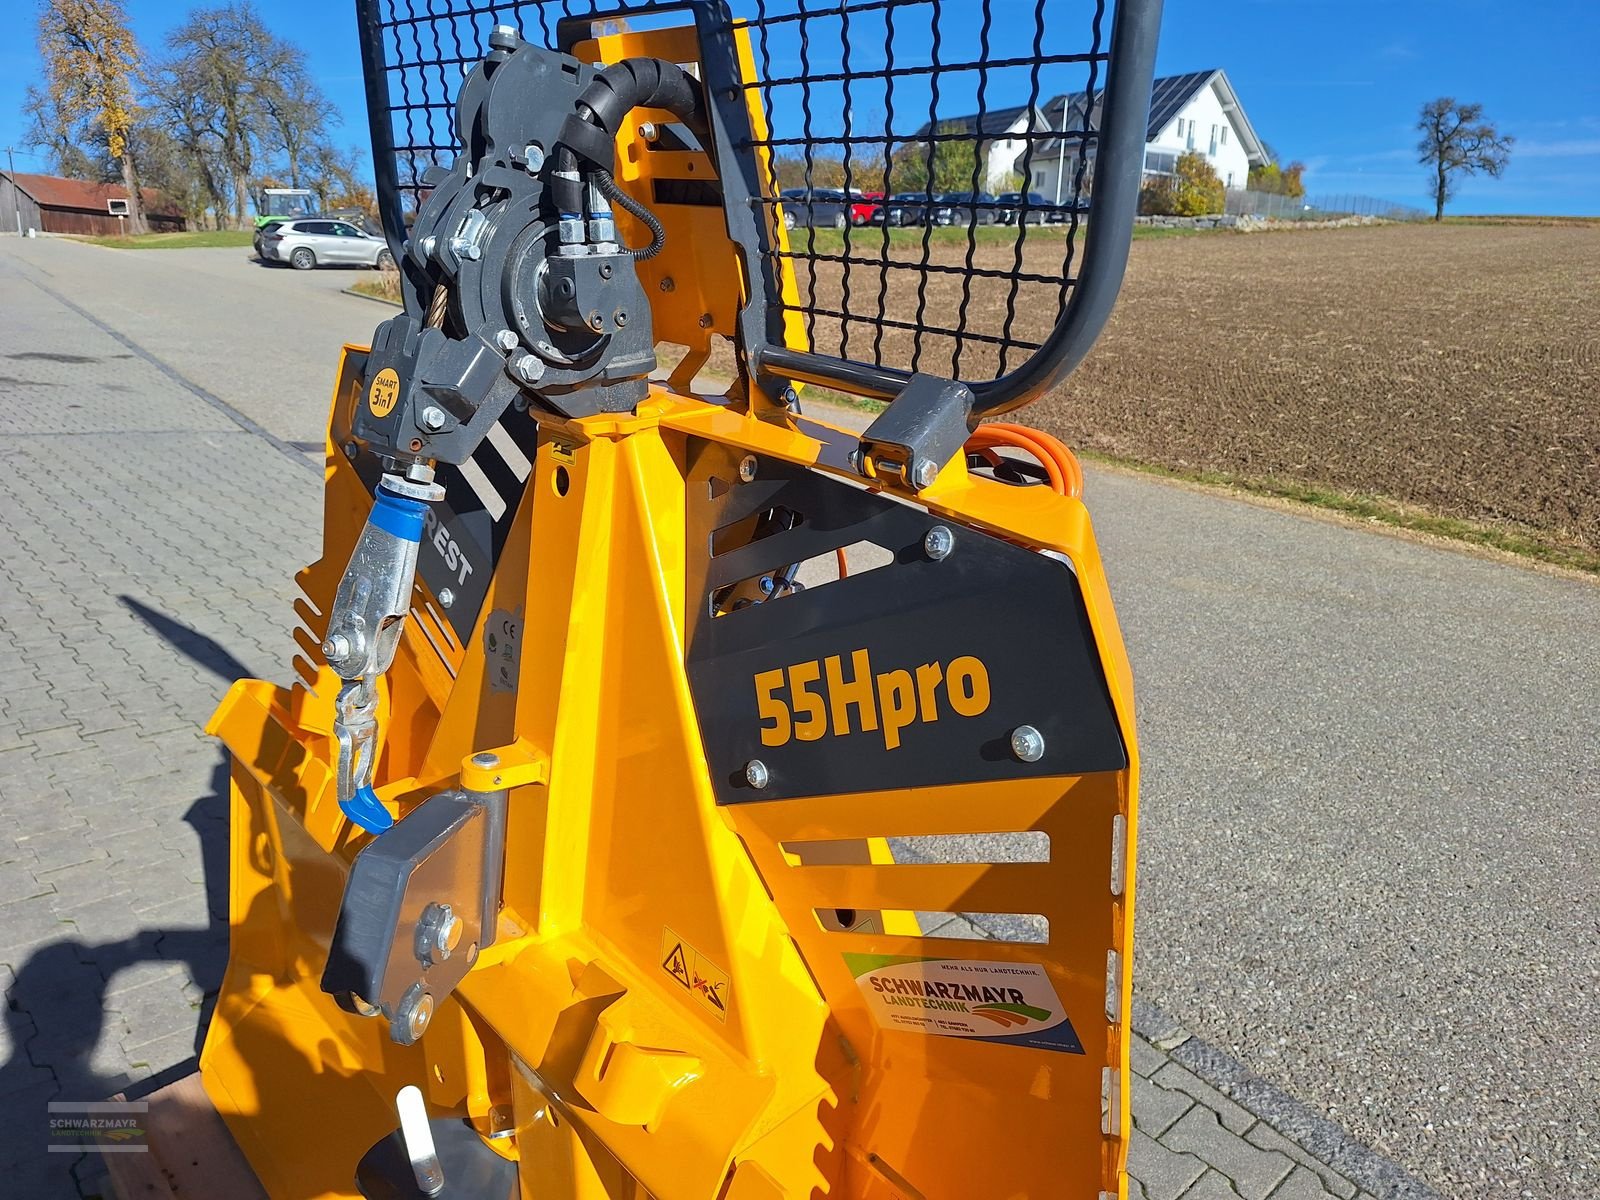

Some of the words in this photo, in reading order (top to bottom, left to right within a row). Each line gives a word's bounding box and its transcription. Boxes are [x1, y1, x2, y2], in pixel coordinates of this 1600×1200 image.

[376, 376, 398, 390] SMART
[372, 387, 393, 409] 3in1
[754, 648, 991, 751] 55Hpro
[869, 976, 1028, 1006] SCHWARZMAYR
[882, 994, 971, 1014] LANDTECHNIK
